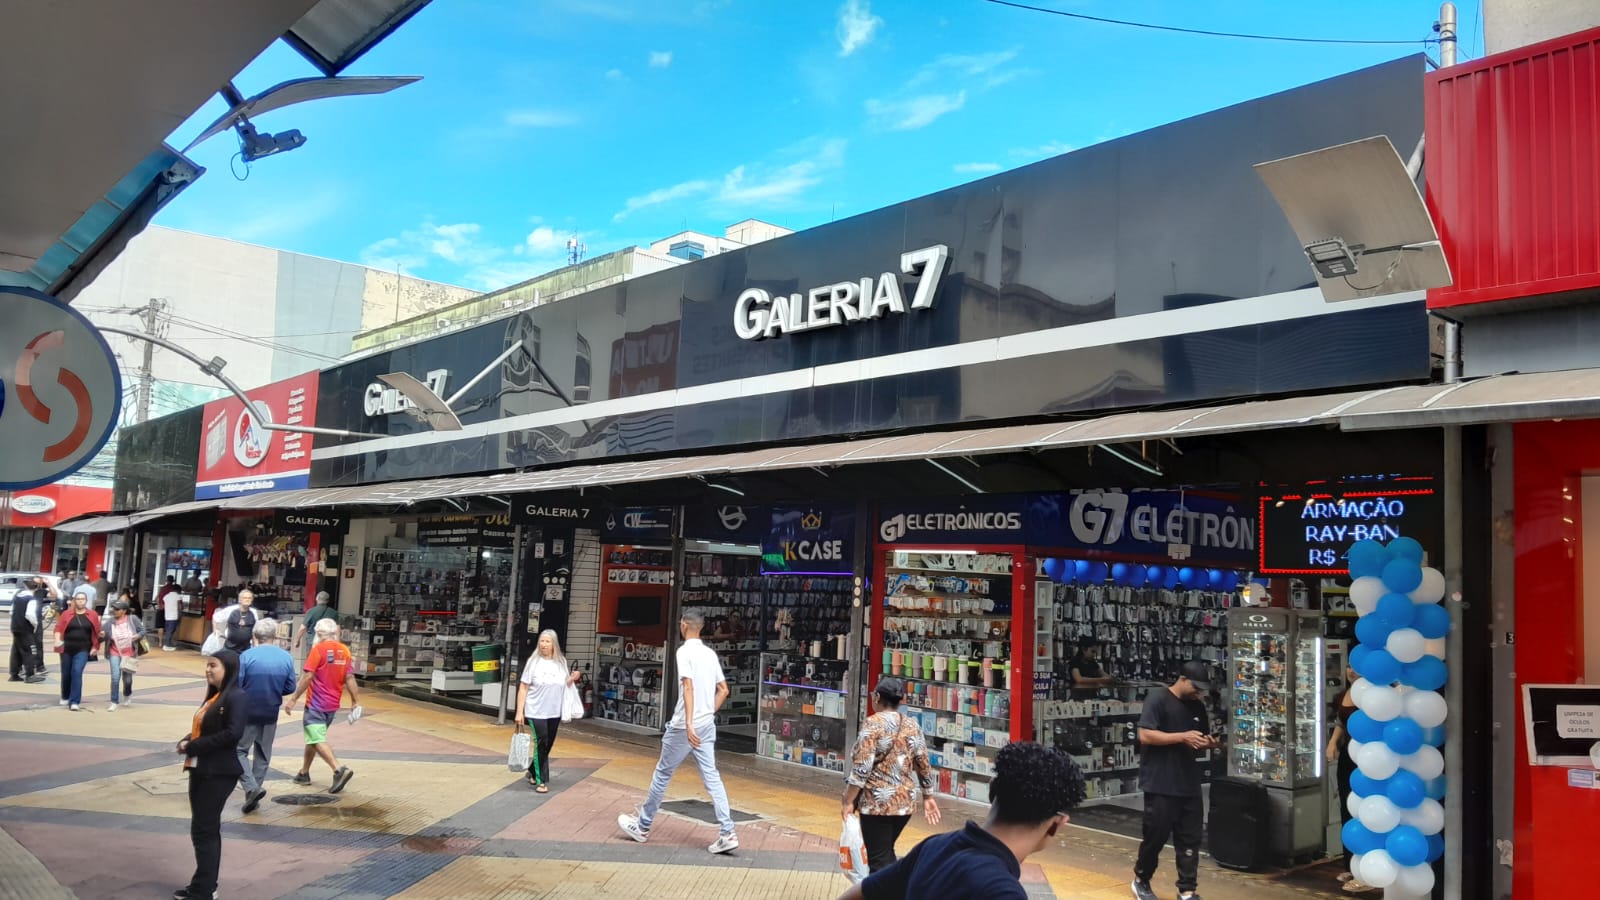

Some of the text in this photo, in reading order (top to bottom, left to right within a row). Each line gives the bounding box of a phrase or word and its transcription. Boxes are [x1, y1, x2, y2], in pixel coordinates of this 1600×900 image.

[733, 244, 949, 341] GALERIA 7
[525, 504, 590, 519] GALERIA 7
[1300, 497, 1404, 520] ARMAÇÃO
[286, 515, 340, 526] GALERIA 7
[624, 513, 641, 528] CW
[880, 505, 1022, 542] G7 ELETRÔNICOS
[1069, 491, 1130, 546] G7
[1305, 524, 1400, 542] RAY-BAN
[785, 540, 842, 561] K CASE
[1309, 548, 1336, 566] R$
